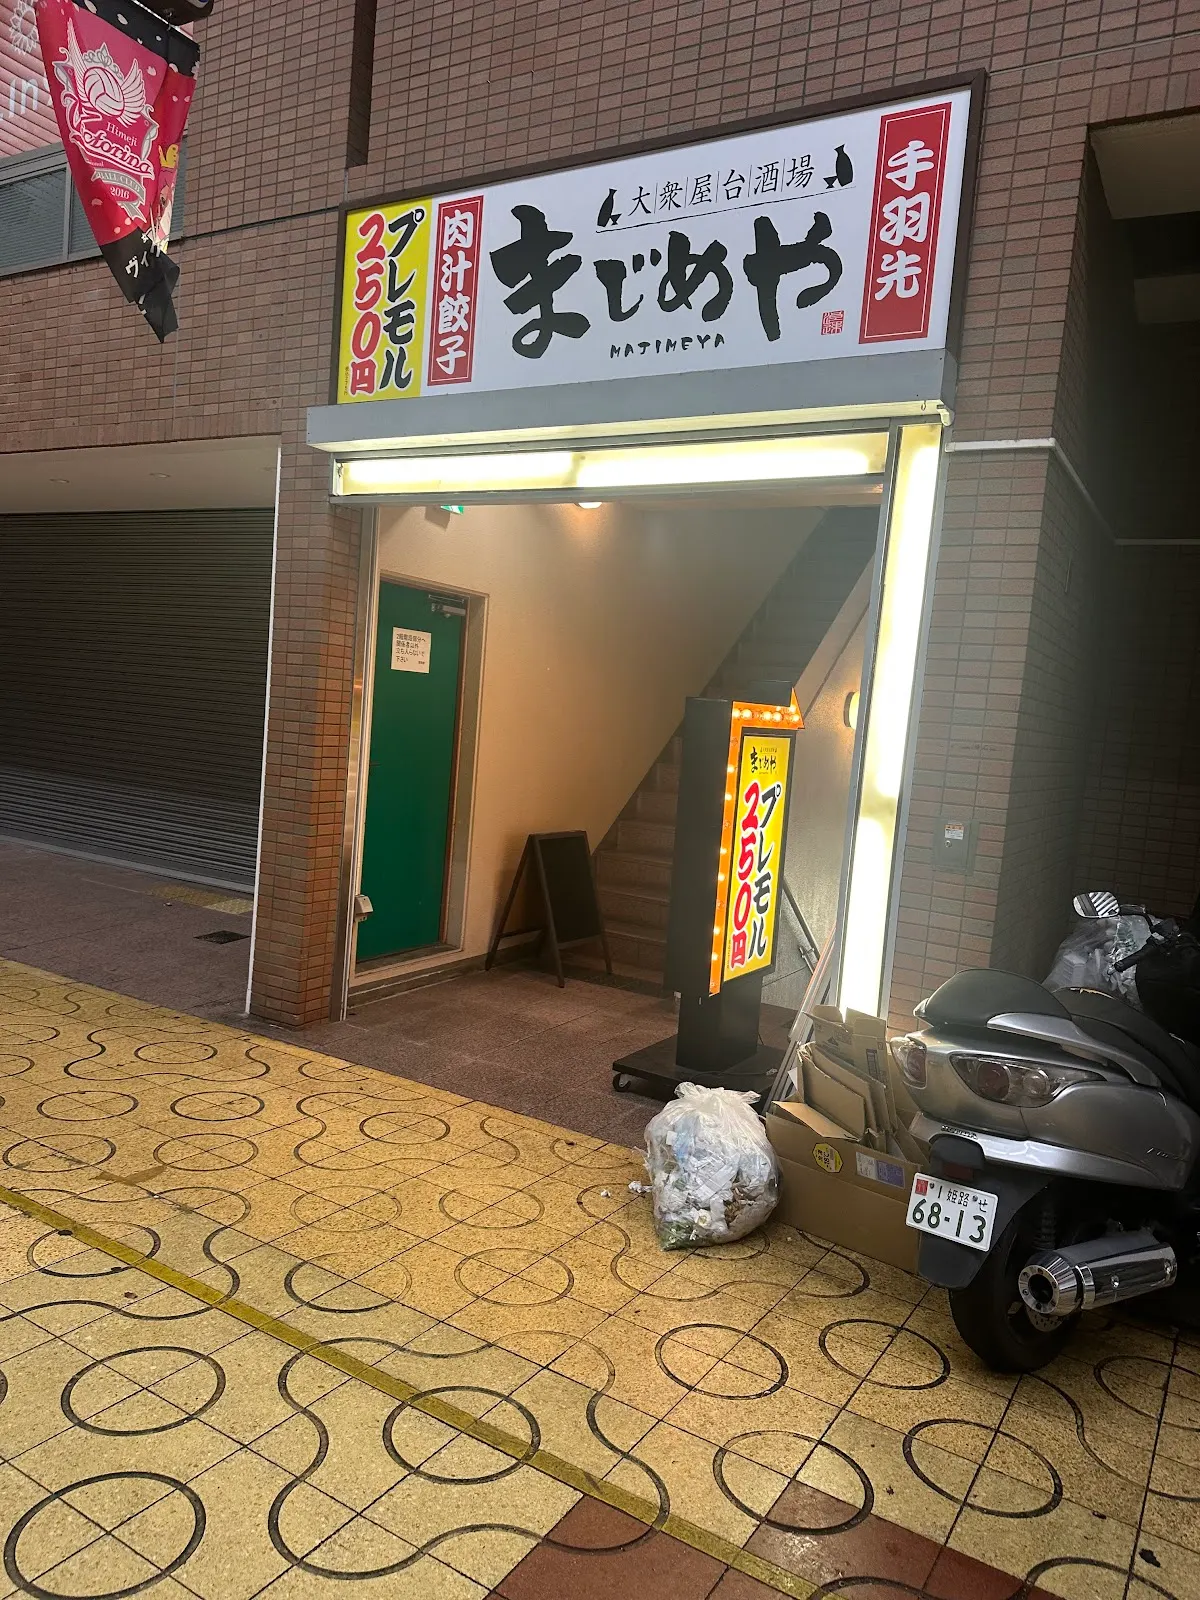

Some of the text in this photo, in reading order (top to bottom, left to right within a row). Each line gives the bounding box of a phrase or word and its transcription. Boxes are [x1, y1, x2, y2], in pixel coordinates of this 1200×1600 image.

[106, 121, 138, 147] Himeji
[110, 186, 130, 200] 2016
[627, 153, 816, 217] 大衆屋台酒場
[379, 207, 425, 390] プレモル
[436, 209, 475, 376] 肉汁餃子
[489, 204, 843, 360] まじめや
[874, 140, 935, 301] 手羽先
[350, 212, 386, 396] 250円
[610, 333, 725, 358] MAJIMEYA
[730, 781, 760, 969] 250円
[747, 783, 782, 960] プレモル
[912, 1198, 987, 1244] 68-13
